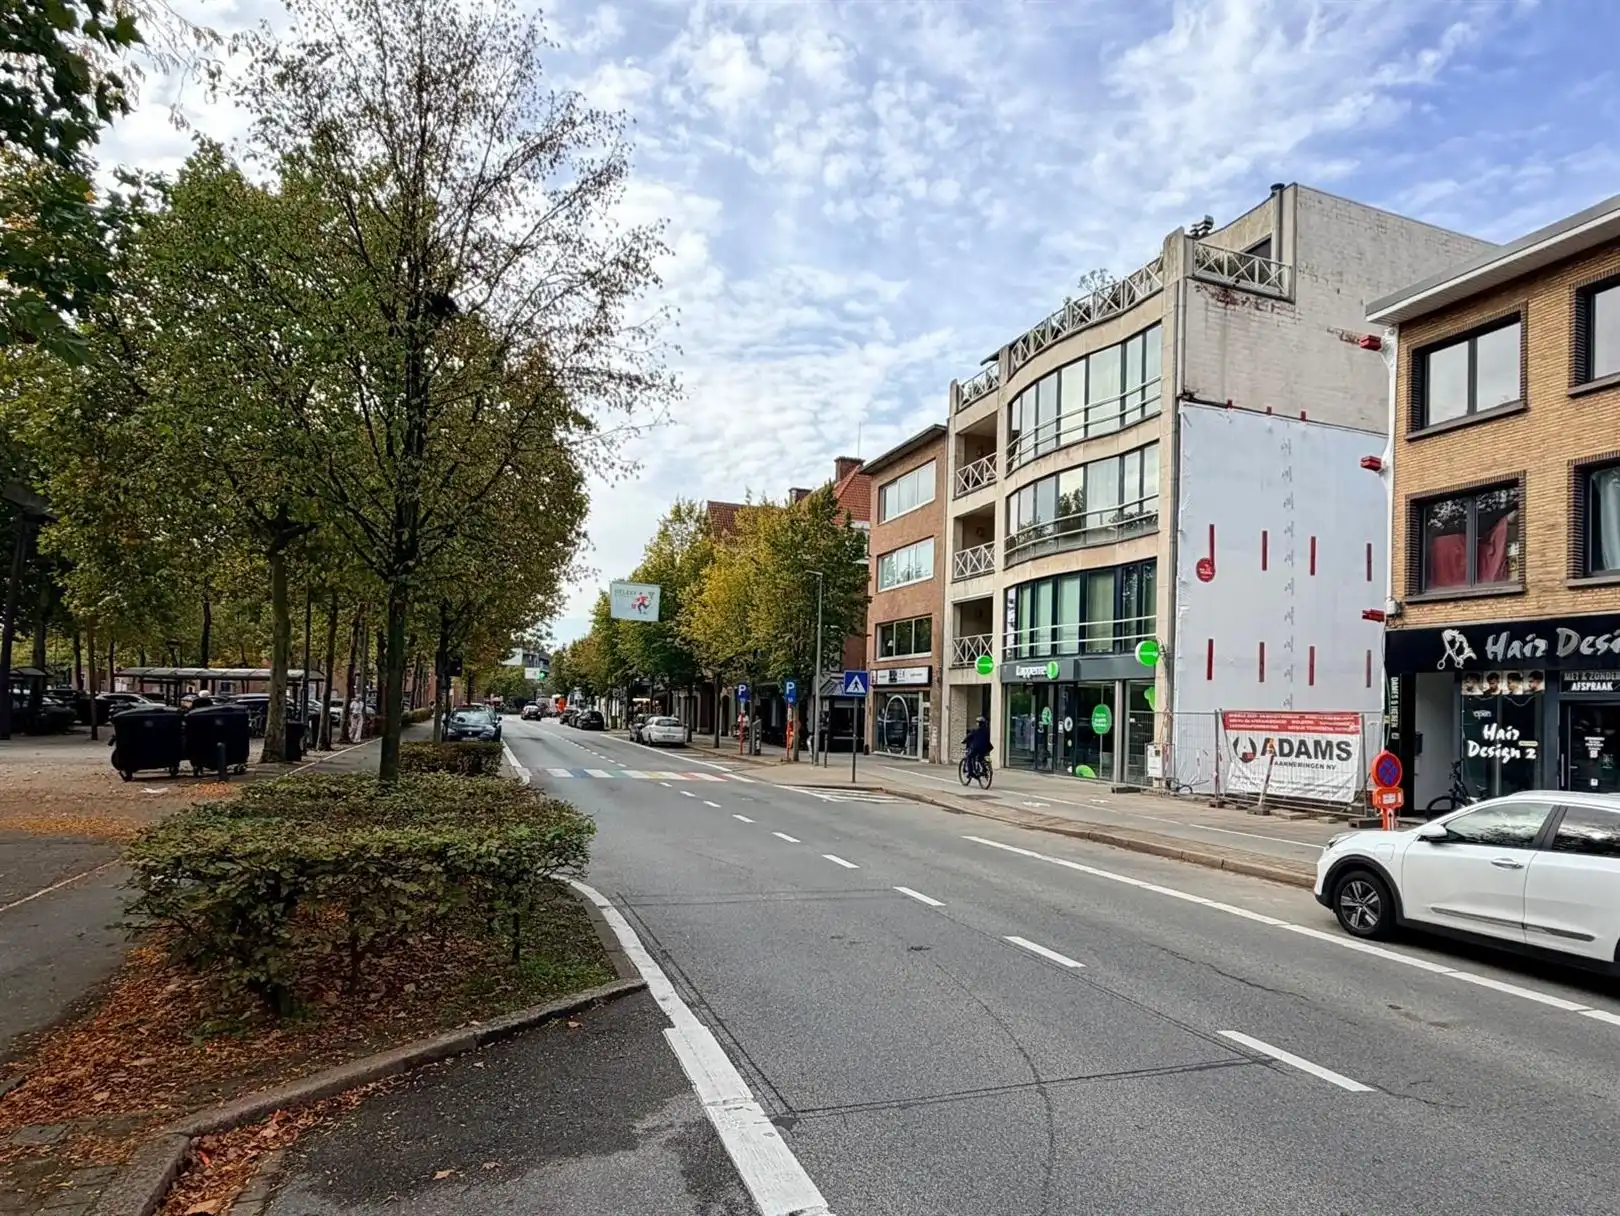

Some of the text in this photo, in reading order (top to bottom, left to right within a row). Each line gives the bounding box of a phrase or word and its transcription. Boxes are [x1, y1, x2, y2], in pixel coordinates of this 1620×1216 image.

[1485, 631, 1548, 663] Hair
[738, 684, 747, 696] P
[786, 681, 795, 694] P
[1390, 676, 1399, 699] DAMES
[1570, 681, 1614, 692] AFSPRAAK
[1472, 709, 1492, 720] open
[1482, 722, 1520, 741] Hair
[1260, 737, 1353, 762] ADAMS
[1466, 739, 1537, 764] Design 2
[1273, 760, 1337, 771] AANNEMINGEN NV
